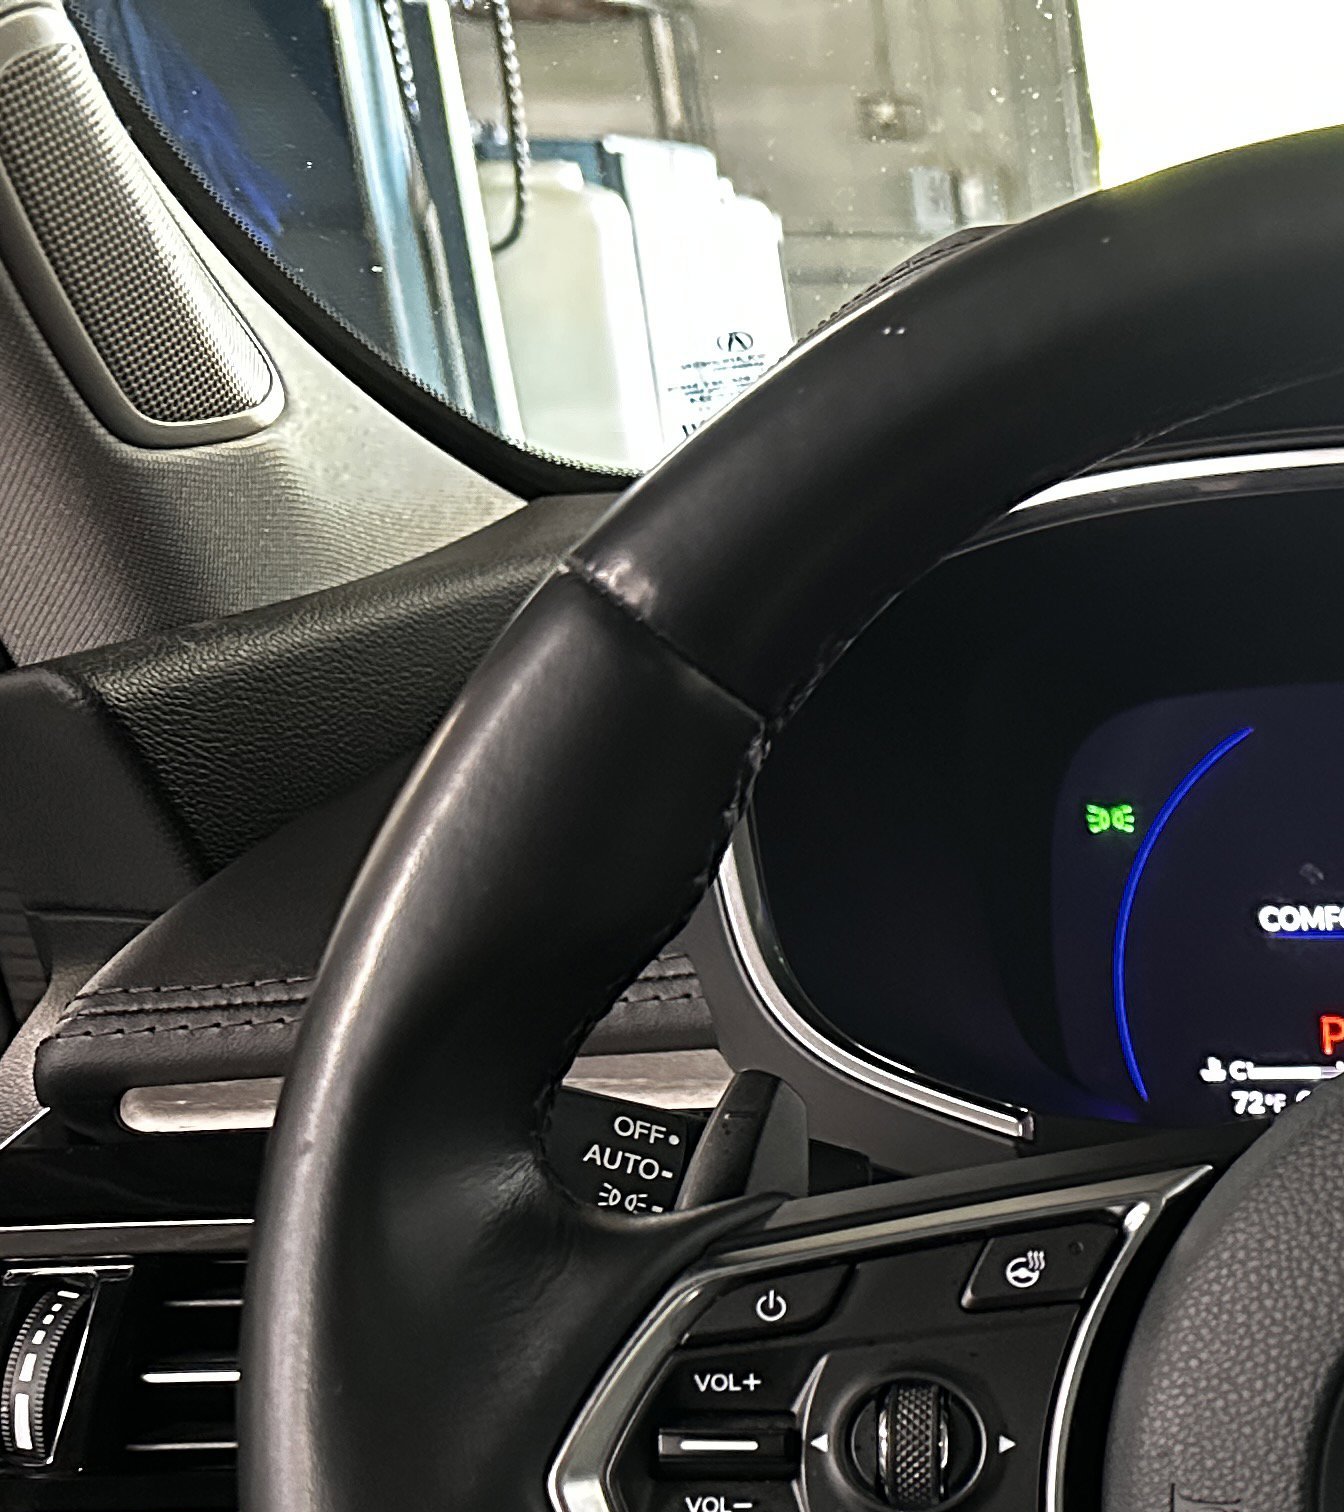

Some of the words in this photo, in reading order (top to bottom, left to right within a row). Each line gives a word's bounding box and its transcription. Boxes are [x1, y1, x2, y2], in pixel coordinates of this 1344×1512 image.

[614, 1116, 667, 1144] OFF
[583, 1143, 660, 1179] AUTO
[694, 1373, 762, 1392] VOL+
